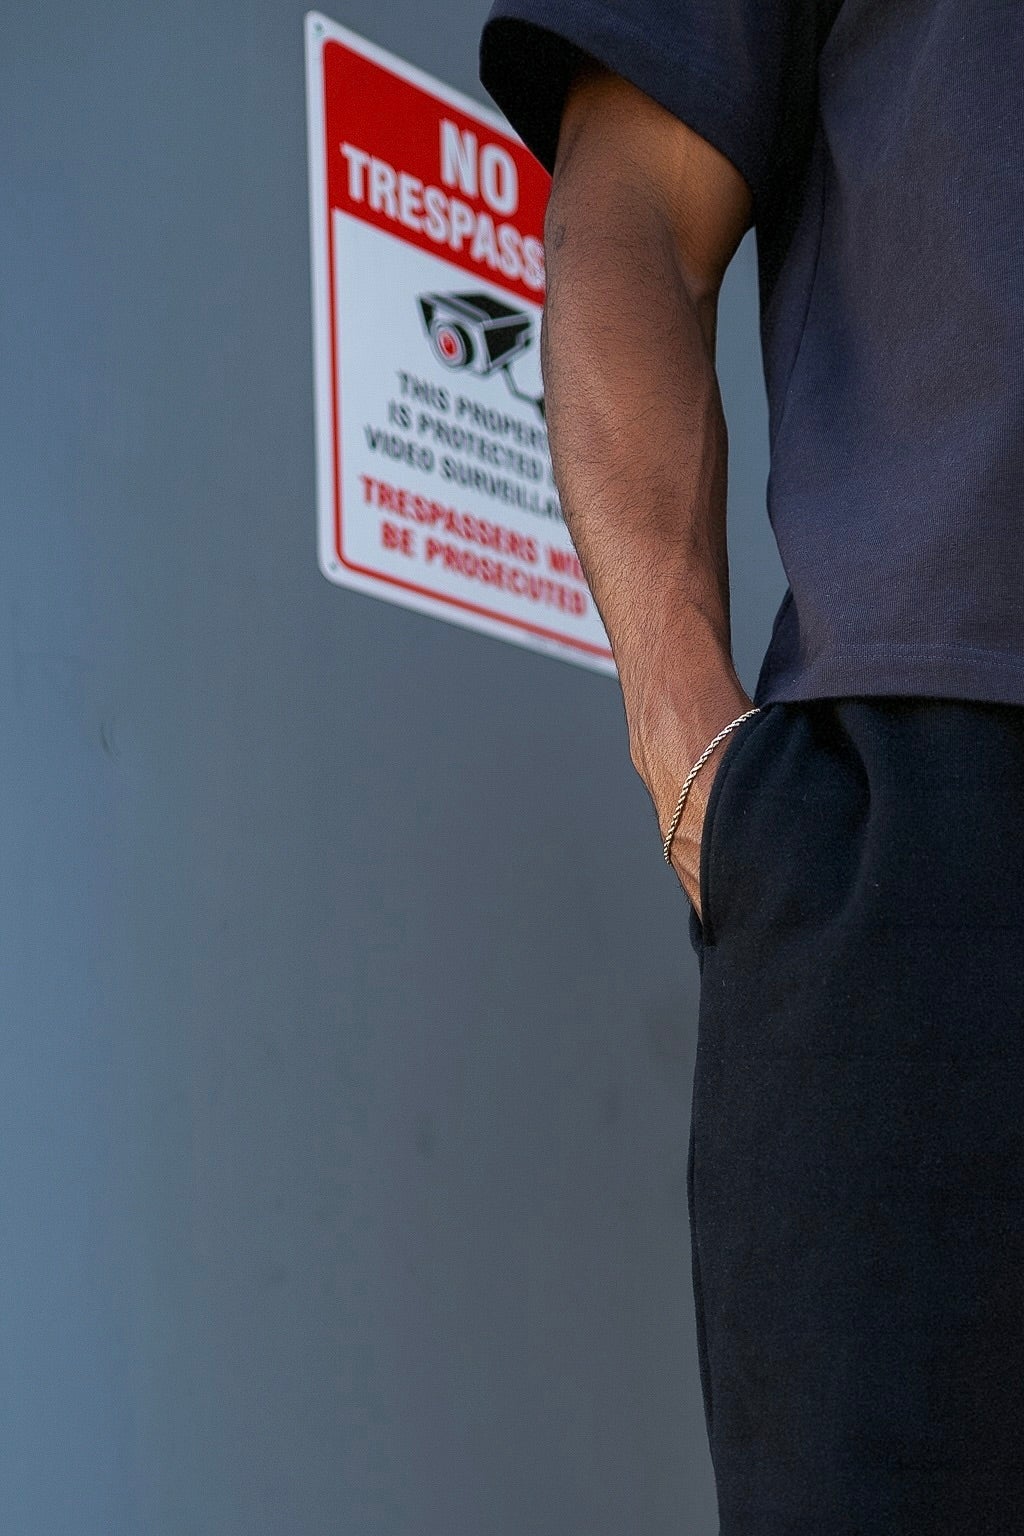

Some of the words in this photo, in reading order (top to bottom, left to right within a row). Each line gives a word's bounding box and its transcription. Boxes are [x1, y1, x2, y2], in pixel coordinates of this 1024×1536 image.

[440, 118, 519, 217] NO
[339, 141, 546, 291] TRESPASS
[398, 371, 449, 412] THIS
[364, 423, 435, 473] VIDEO
[388, 399, 412, 429] IS
[417, 411, 544, 483] PROTECTED
[359, 473, 538, 563] TRESPASSERS
[380, 520, 414, 558] BE
[425, 536, 588, 617] PROSECUTED
